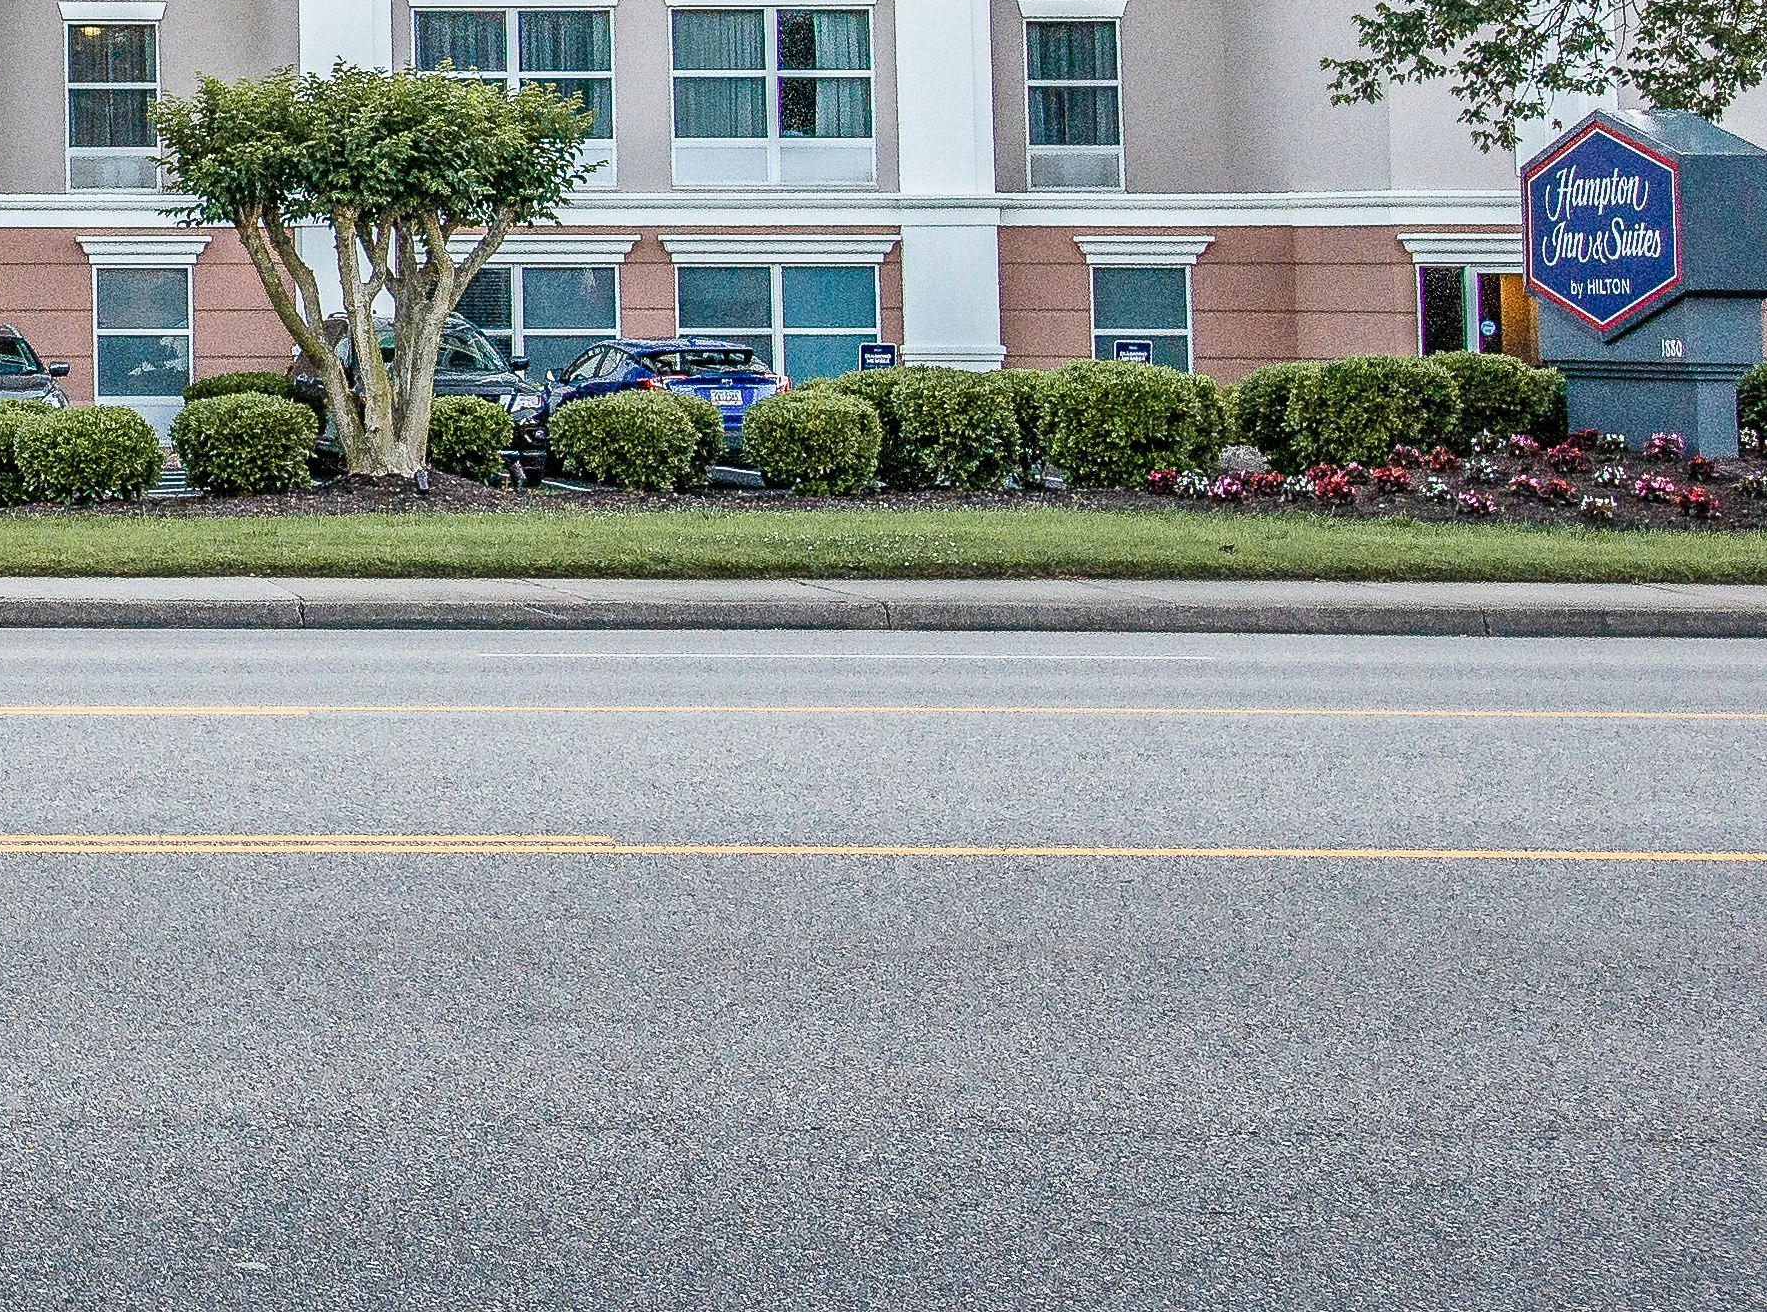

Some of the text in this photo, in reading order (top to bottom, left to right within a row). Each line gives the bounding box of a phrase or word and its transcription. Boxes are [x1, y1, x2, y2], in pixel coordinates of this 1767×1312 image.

[1545, 165, 1649, 221] Hampton
[1541, 217, 1662, 267] Inn & Suites
[1570, 277, 1631, 300] by HILTON
